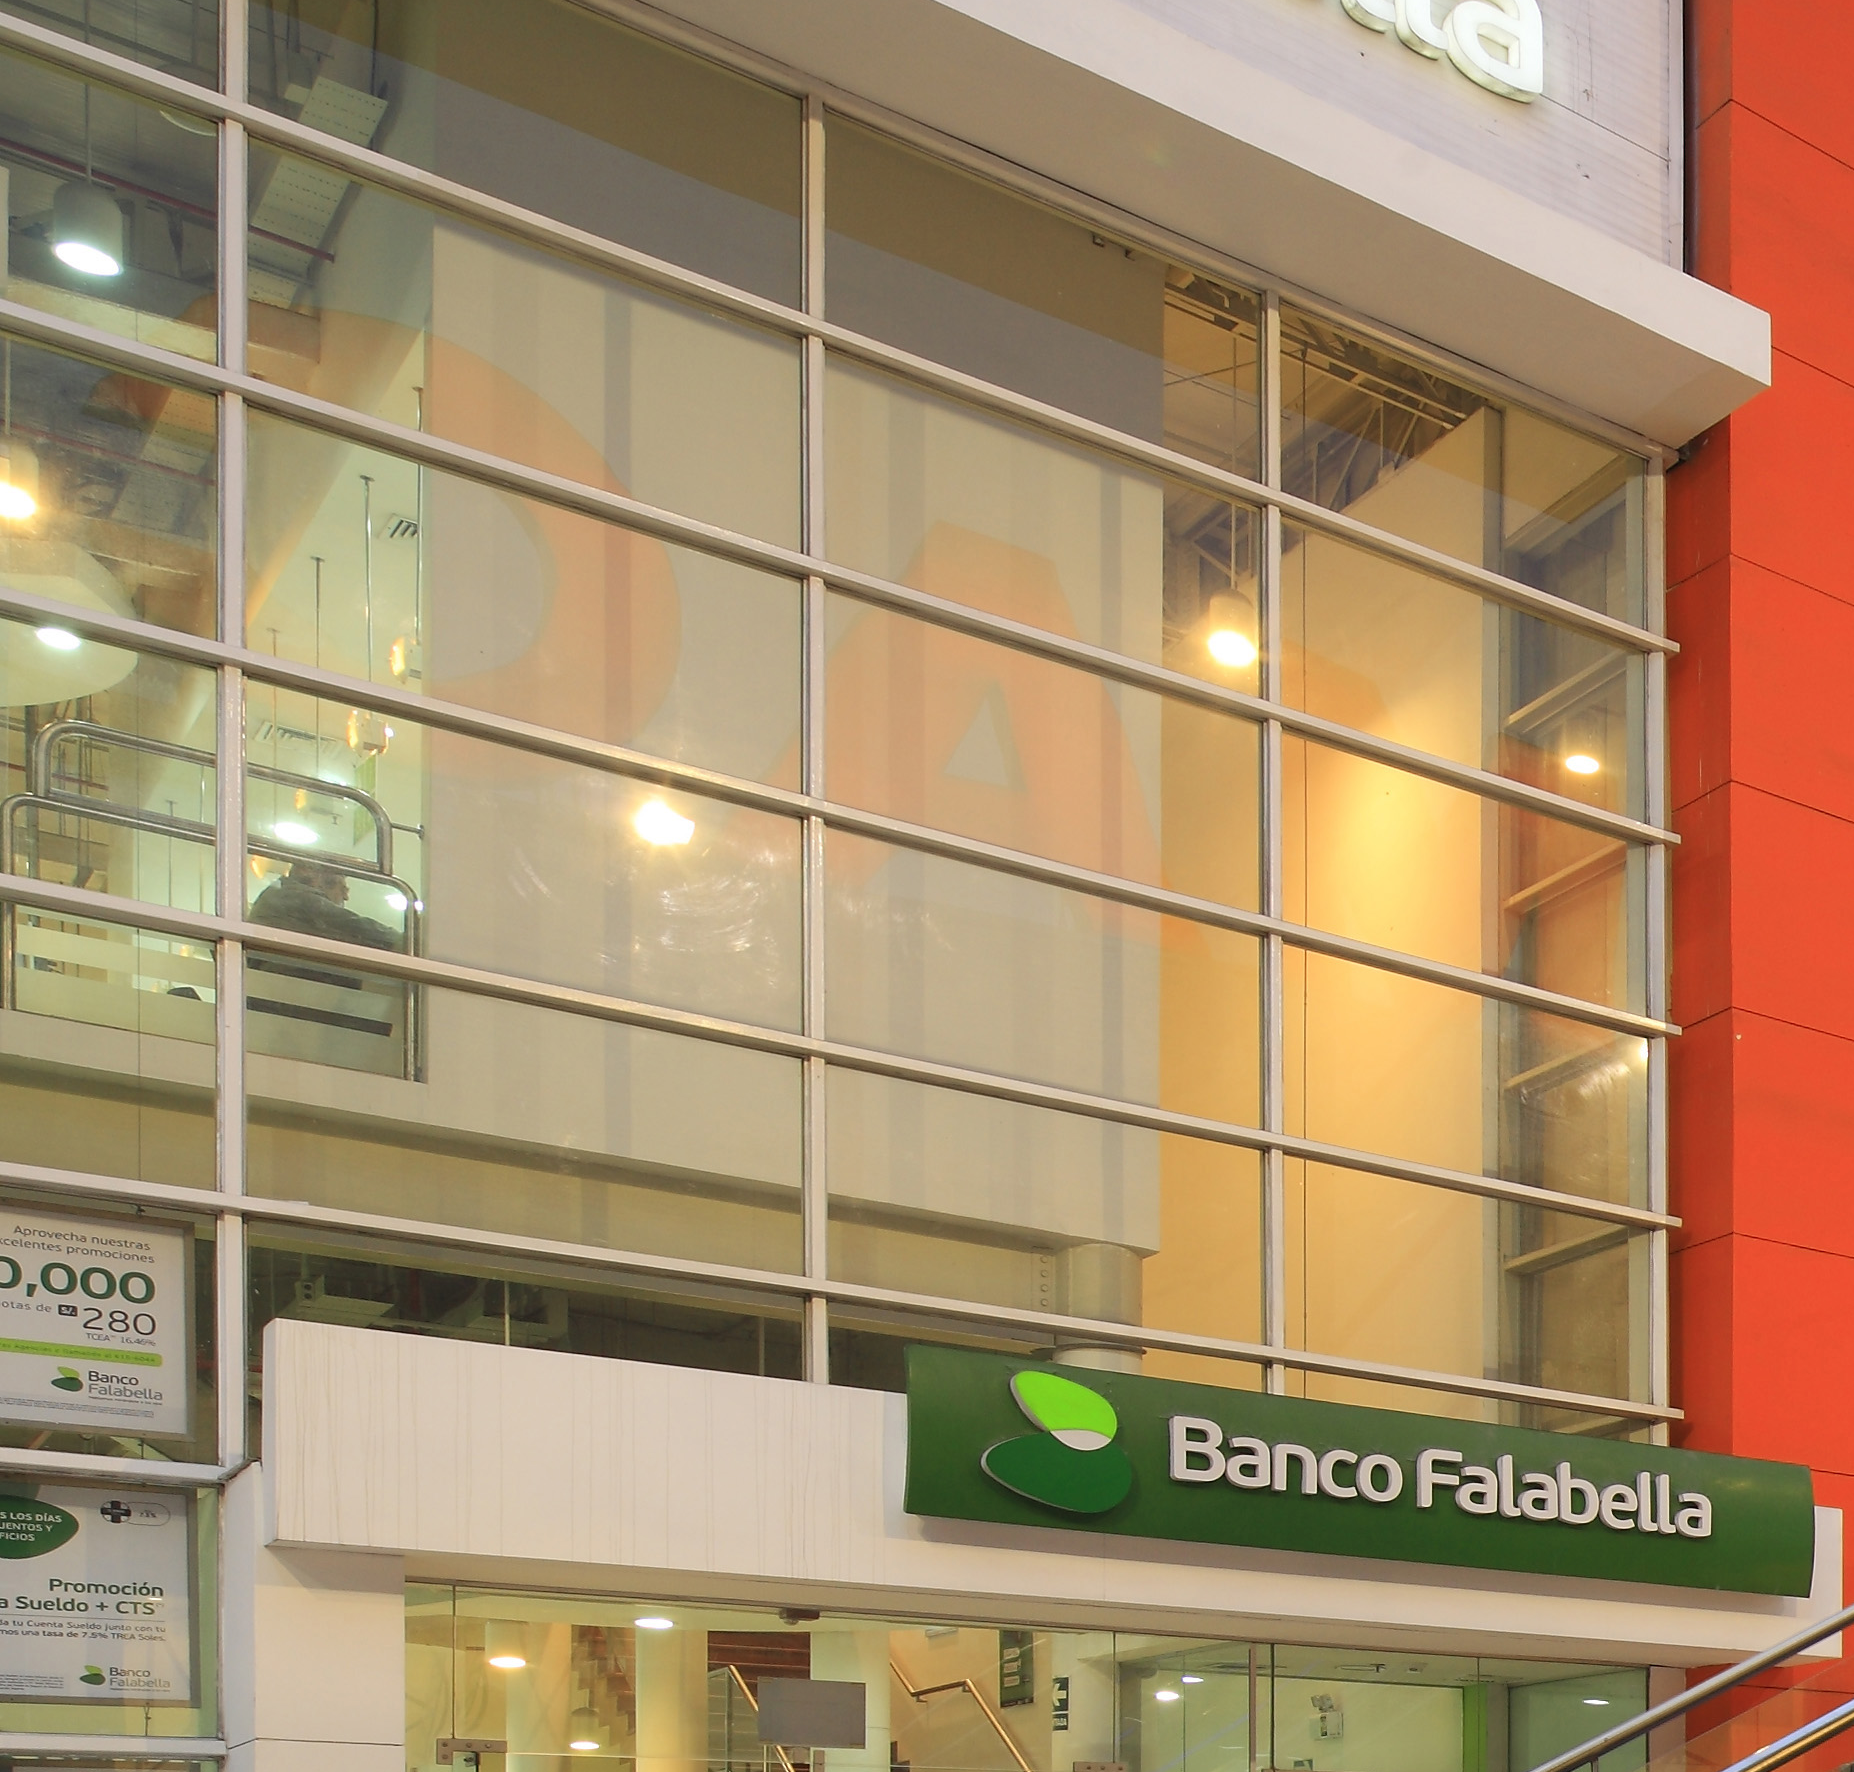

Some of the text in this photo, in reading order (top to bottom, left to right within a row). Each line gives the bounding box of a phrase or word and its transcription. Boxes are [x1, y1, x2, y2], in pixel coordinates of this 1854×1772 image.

[14, 1225, 151, 1251] Aprovecha nuestras
[66, 1245, 155, 1264] promociones
[83, 1308, 157, 1336] 280
[88, 1370, 139, 1386] Banco
[88, 1384, 163, 1401] Falabella
[1168, 1413, 1713, 1540] Banco Falabella
[10, 1512, 33, 1521] LOS
[35, 1511, 63, 1523] DÍAS
[49, 1578, 164, 1597] Promoción
[15, 1596, 89, 1612] Sueldo
[27, 1620, 63, 1628] Cuenta
[67, 1621, 102, 1630] Sueldo
[109, 1667, 151, 1678] Banco
[109, 1677, 171, 1688] Falabella
